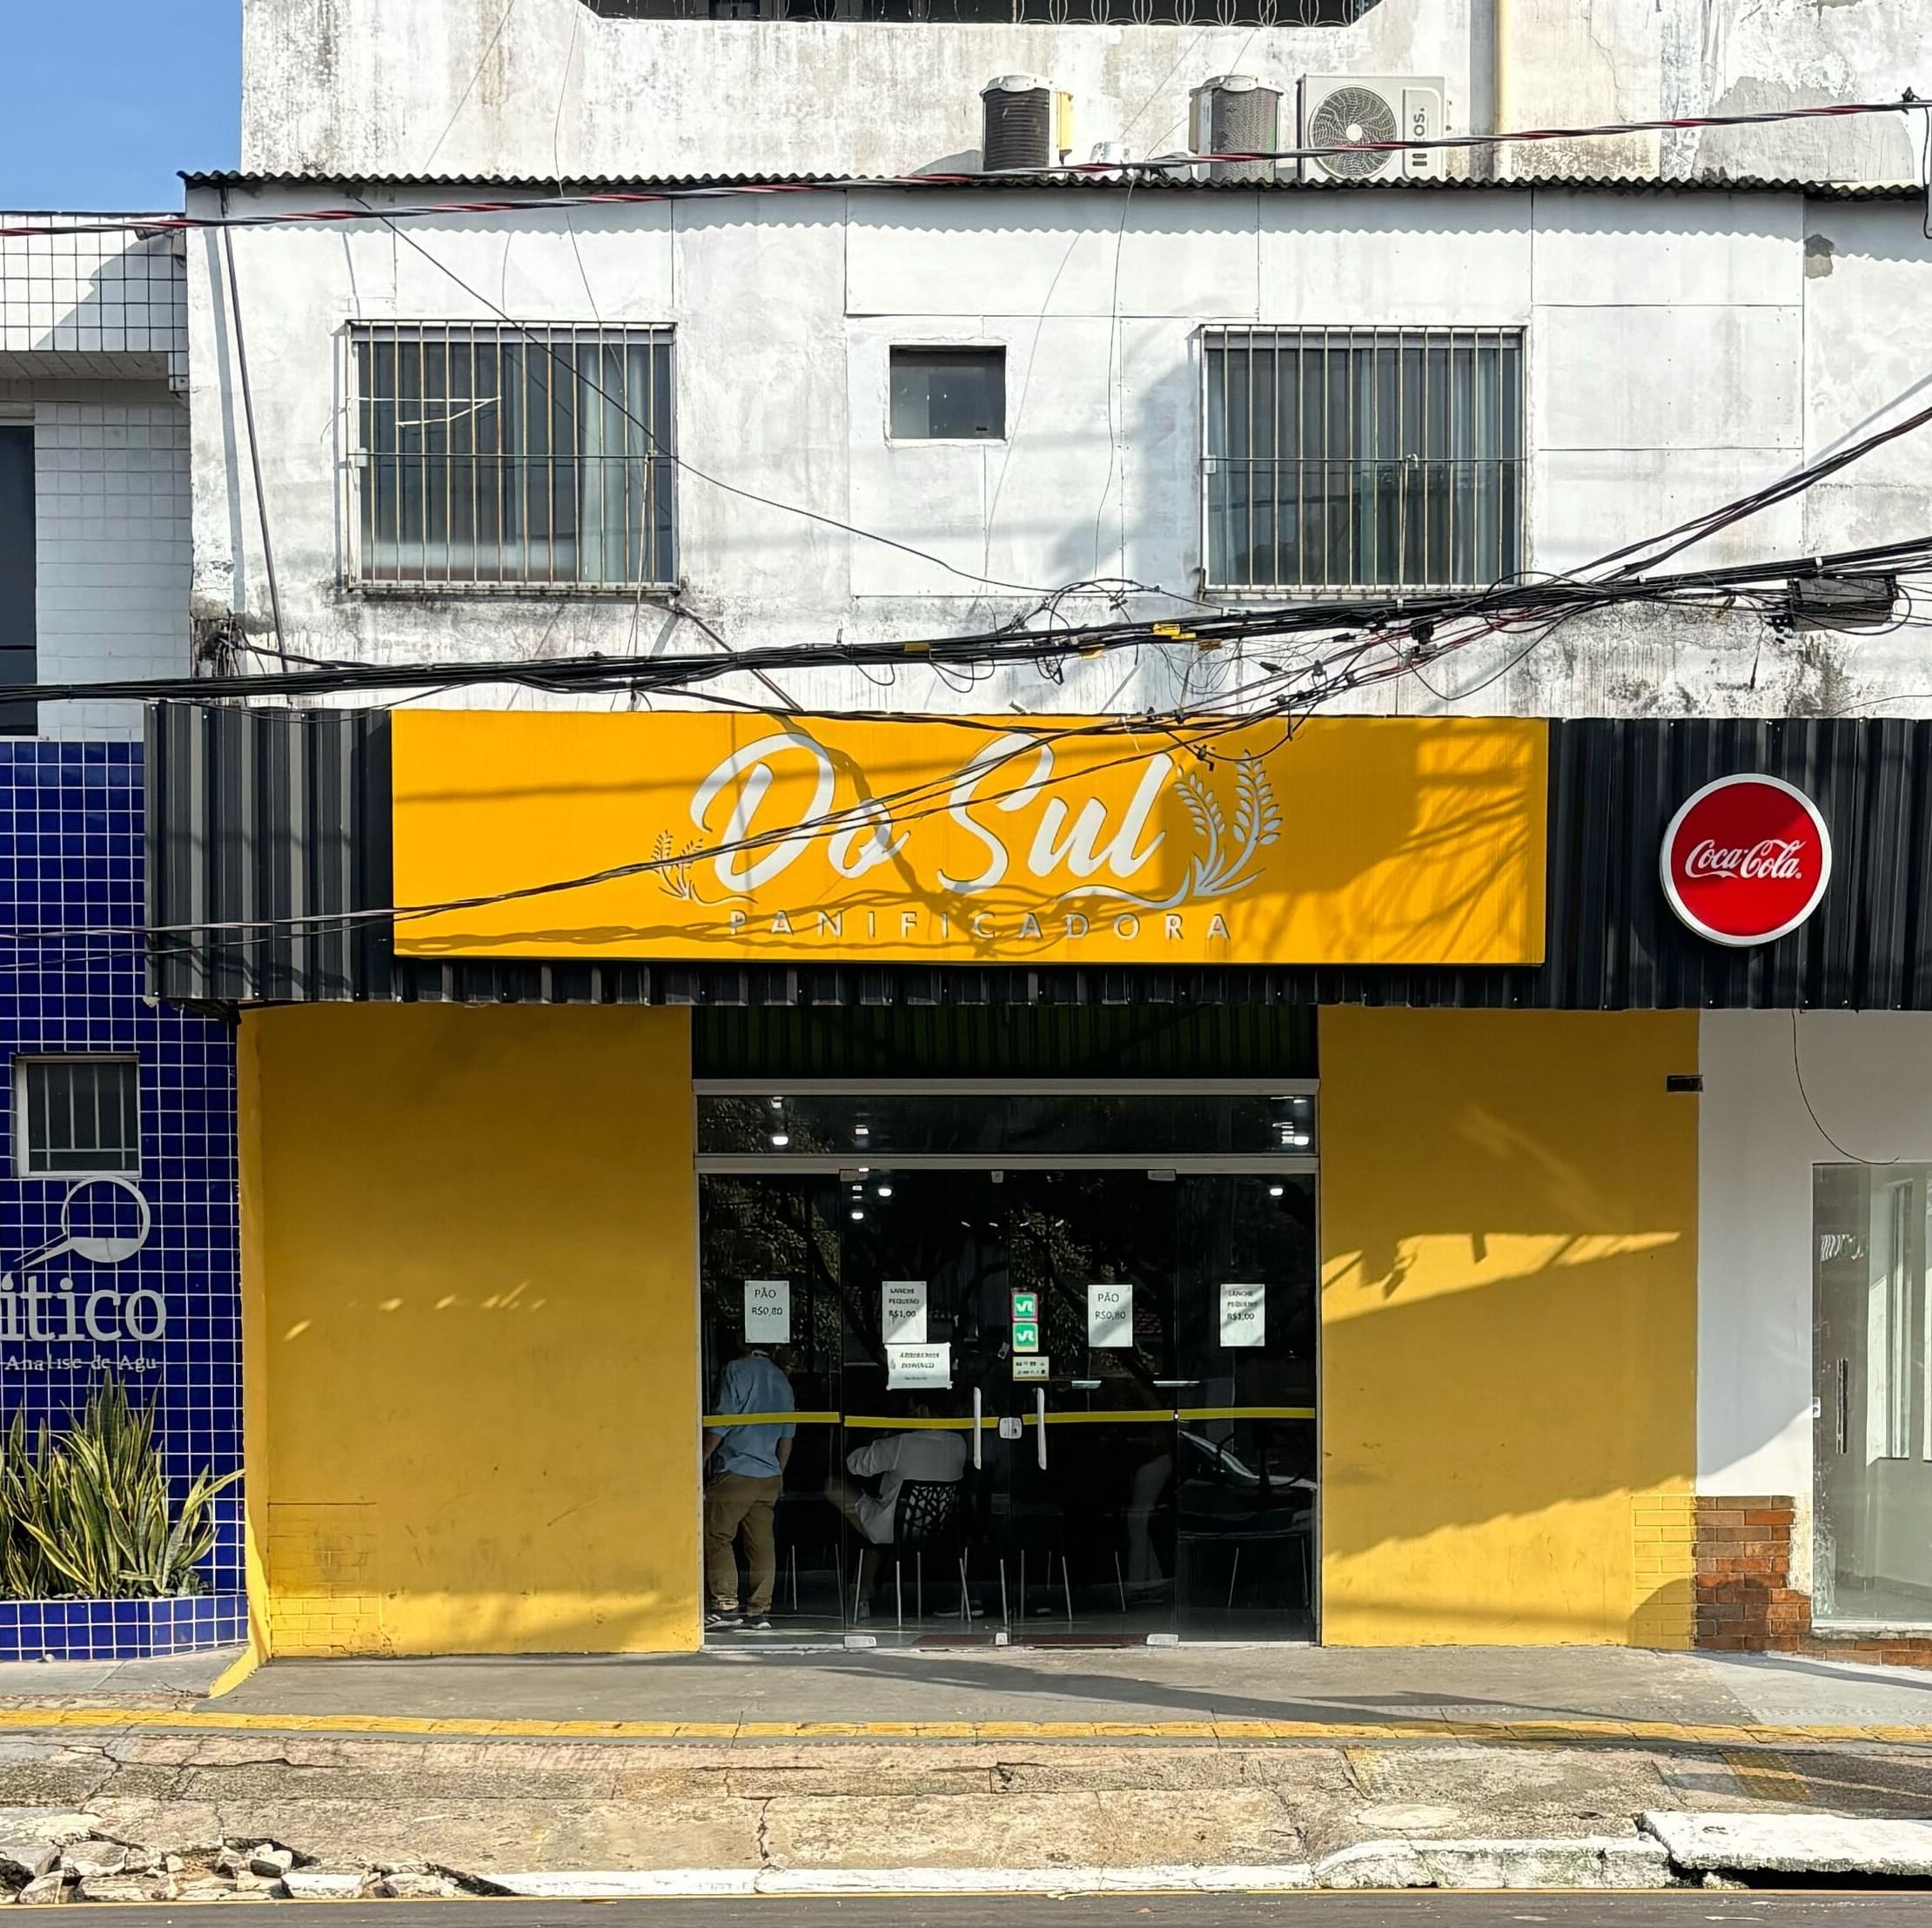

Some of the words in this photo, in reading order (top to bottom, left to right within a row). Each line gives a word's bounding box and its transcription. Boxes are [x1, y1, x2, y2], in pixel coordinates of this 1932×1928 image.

[690, 731, 911, 892] Do
[936, 731, 1174, 895] Sul
[730, 910, 1231, 940] PANIFICADORA
[755, 1287, 776, 1299] PÃO
[1097, 1292, 1120, 1303] PÃO
[91, 1354, 111, 1370] de
